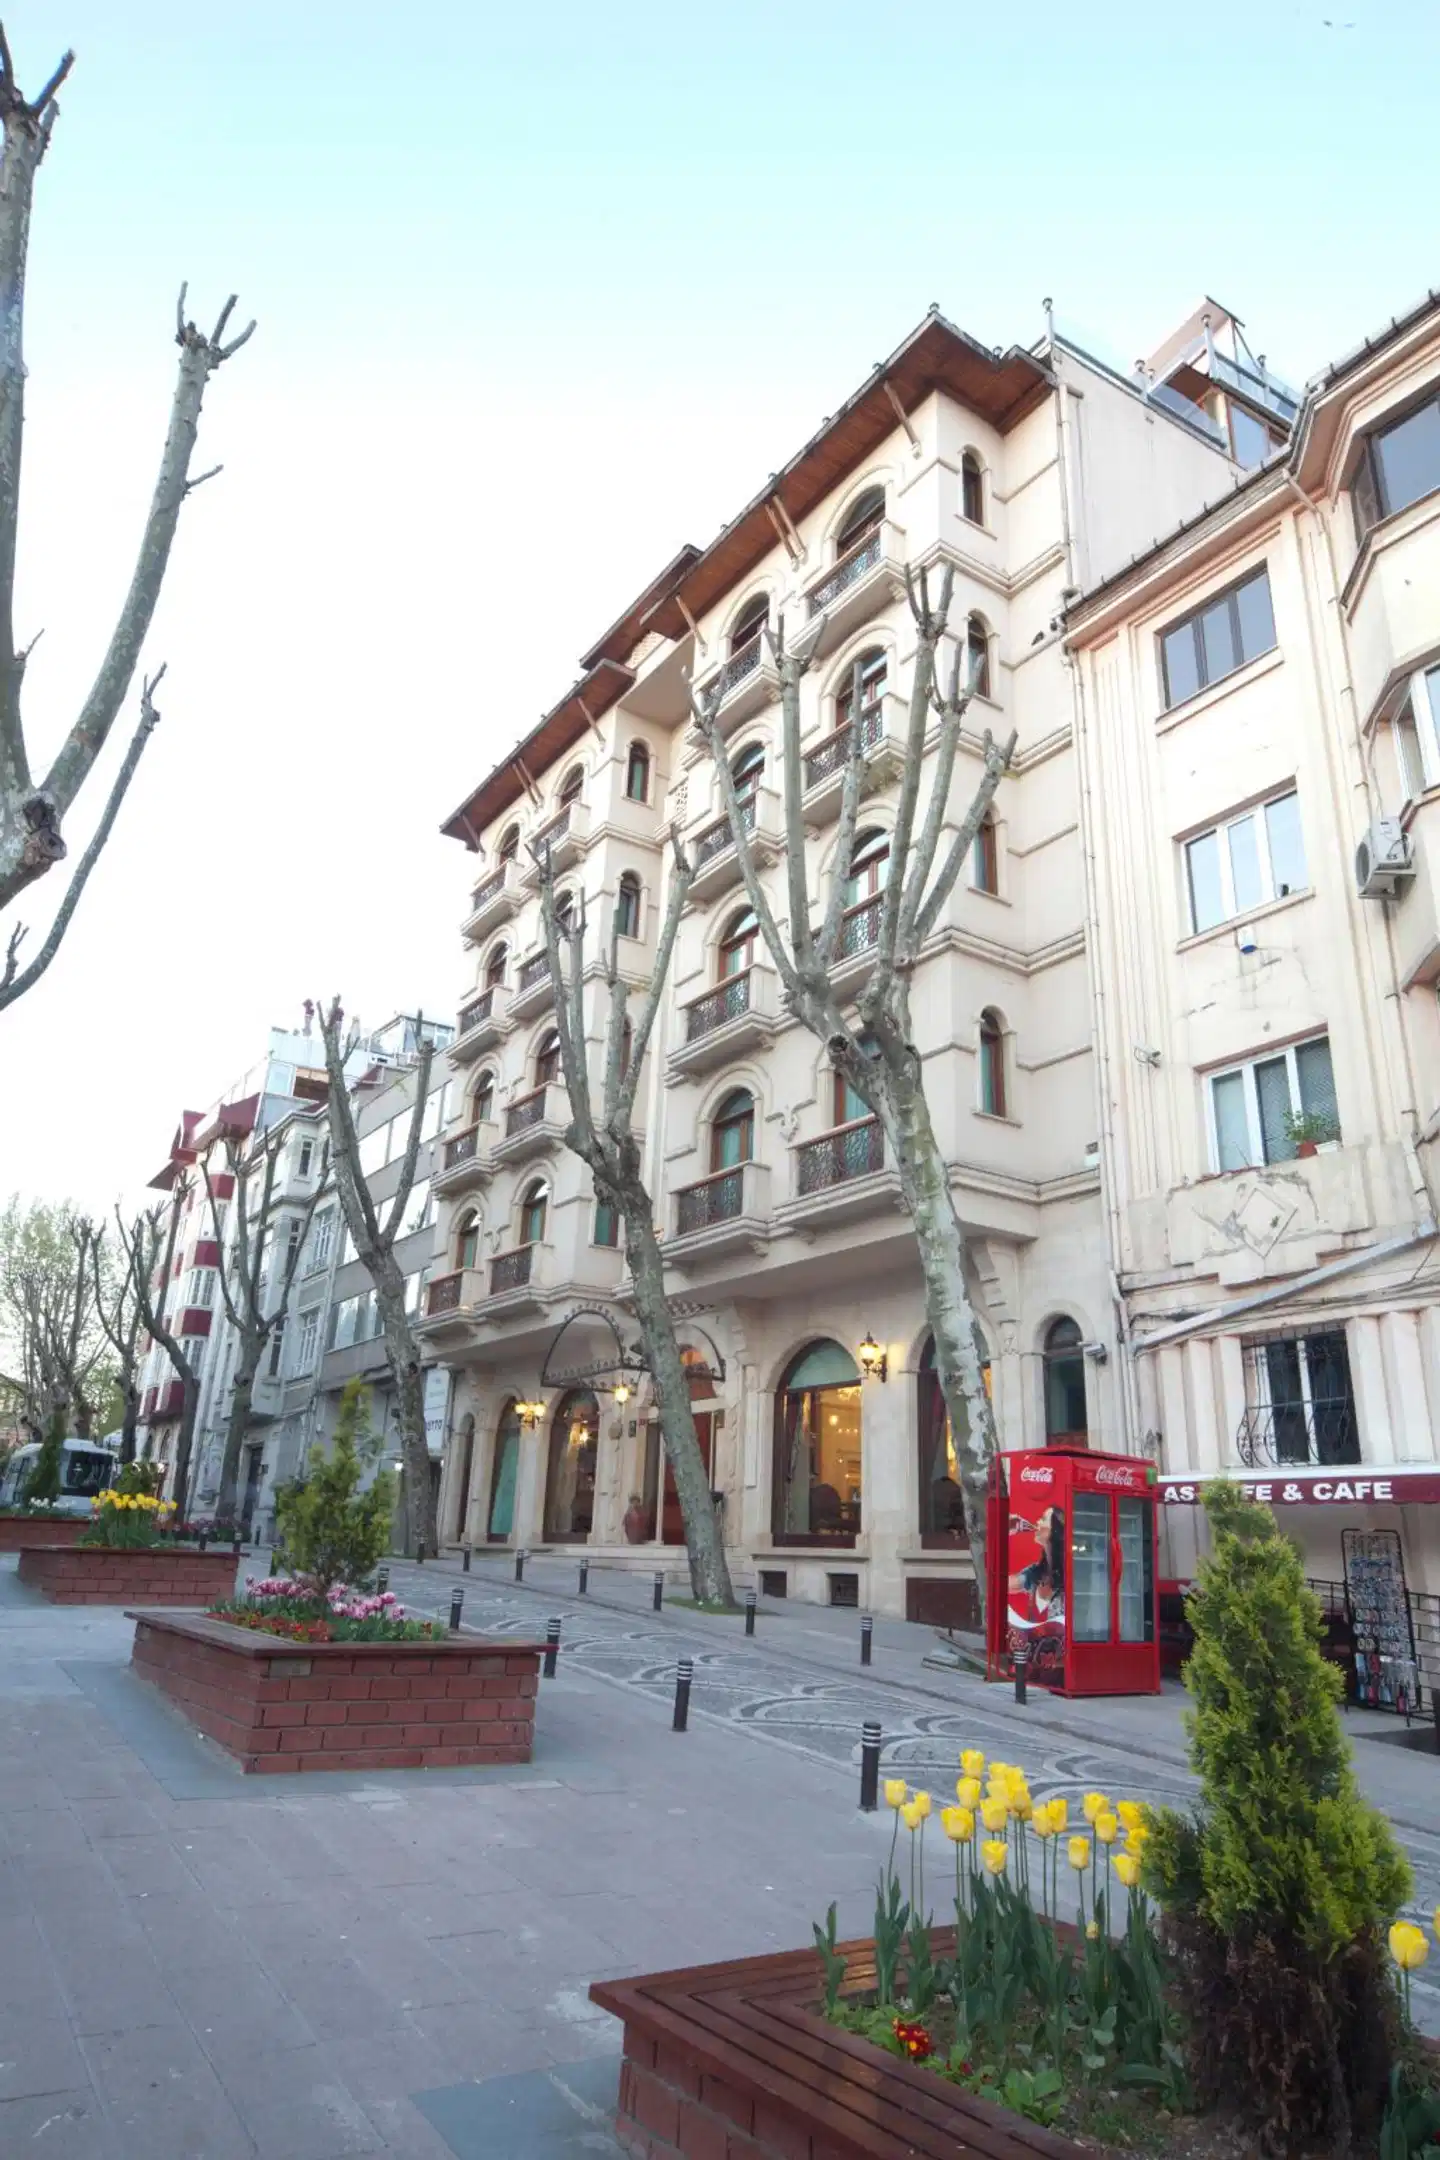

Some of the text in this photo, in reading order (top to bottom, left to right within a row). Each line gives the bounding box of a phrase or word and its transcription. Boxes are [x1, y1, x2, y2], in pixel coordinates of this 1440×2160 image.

[1164, 1486, 1195, 1502] AS
[1282, 1484, 1303, 1501] &
[1312, 1481, 1393, 1500] CAFE
